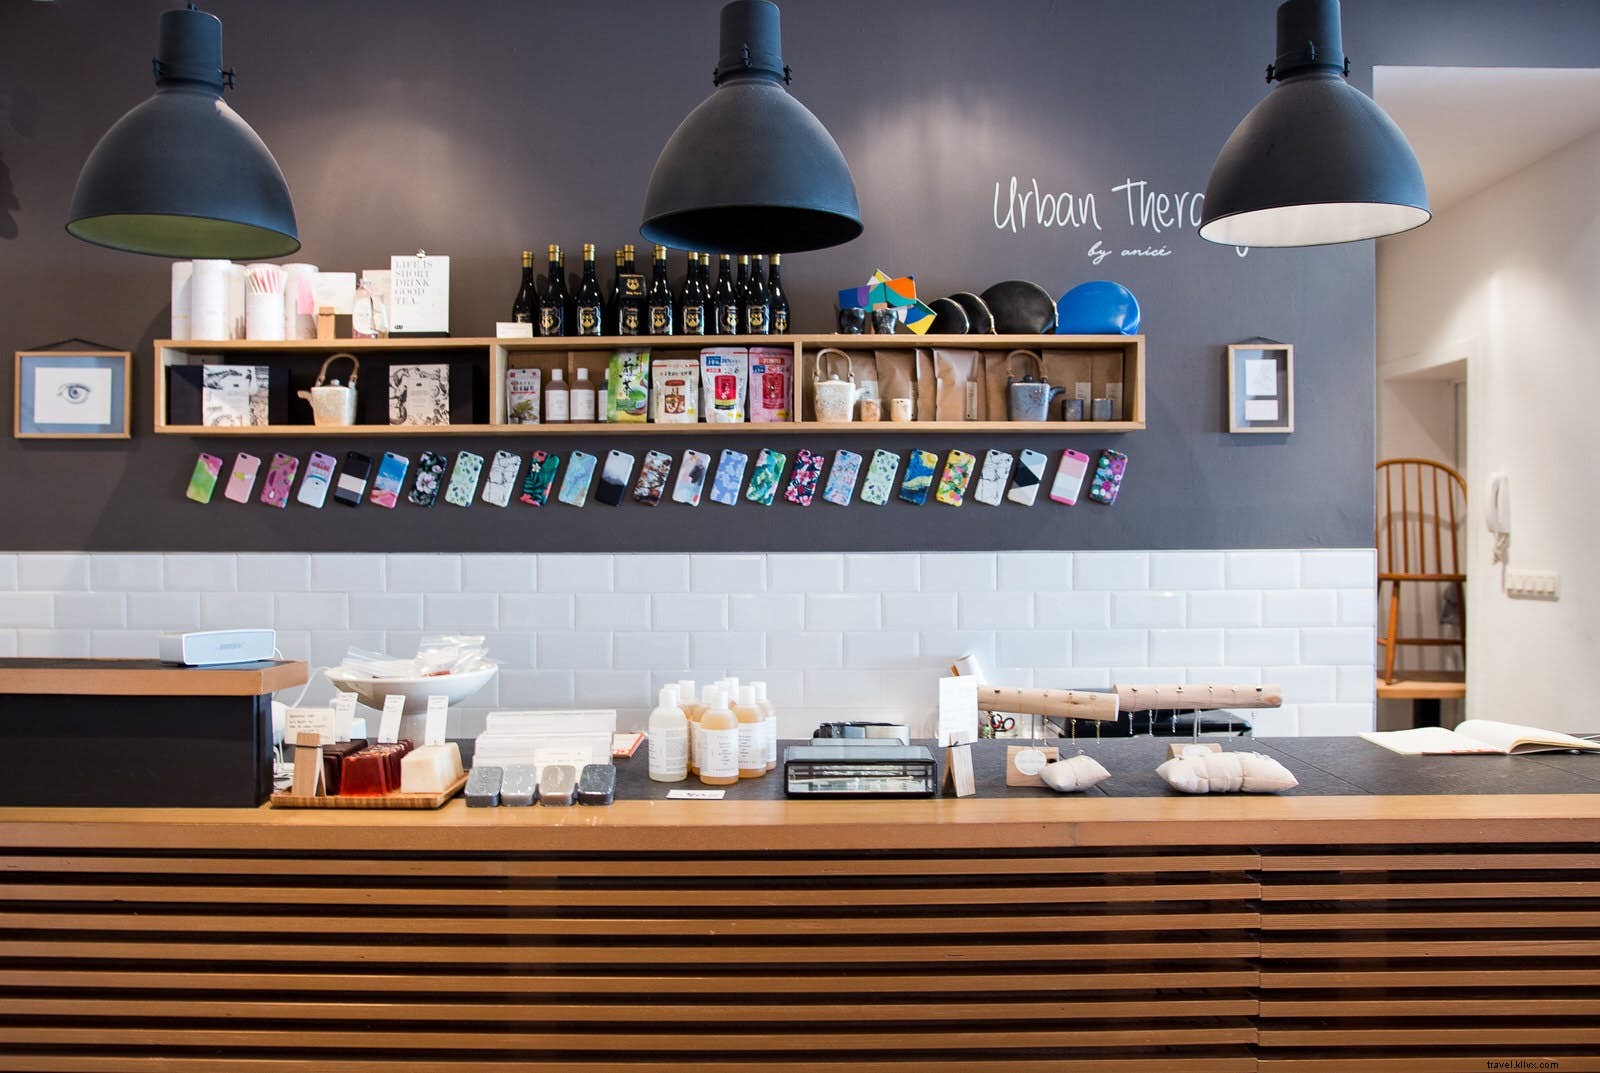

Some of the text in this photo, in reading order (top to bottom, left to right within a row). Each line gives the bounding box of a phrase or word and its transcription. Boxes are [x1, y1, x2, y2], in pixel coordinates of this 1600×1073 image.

[993, 176, 1102, 233] Urban
[1087, 240, 1112, 265] by
[393, 270, 432, 278] SHORT
[395, 279, 430, 287] DRINK
[394, 288, 425, 296] GOOD
[395, 297, 416, 305] TEA
